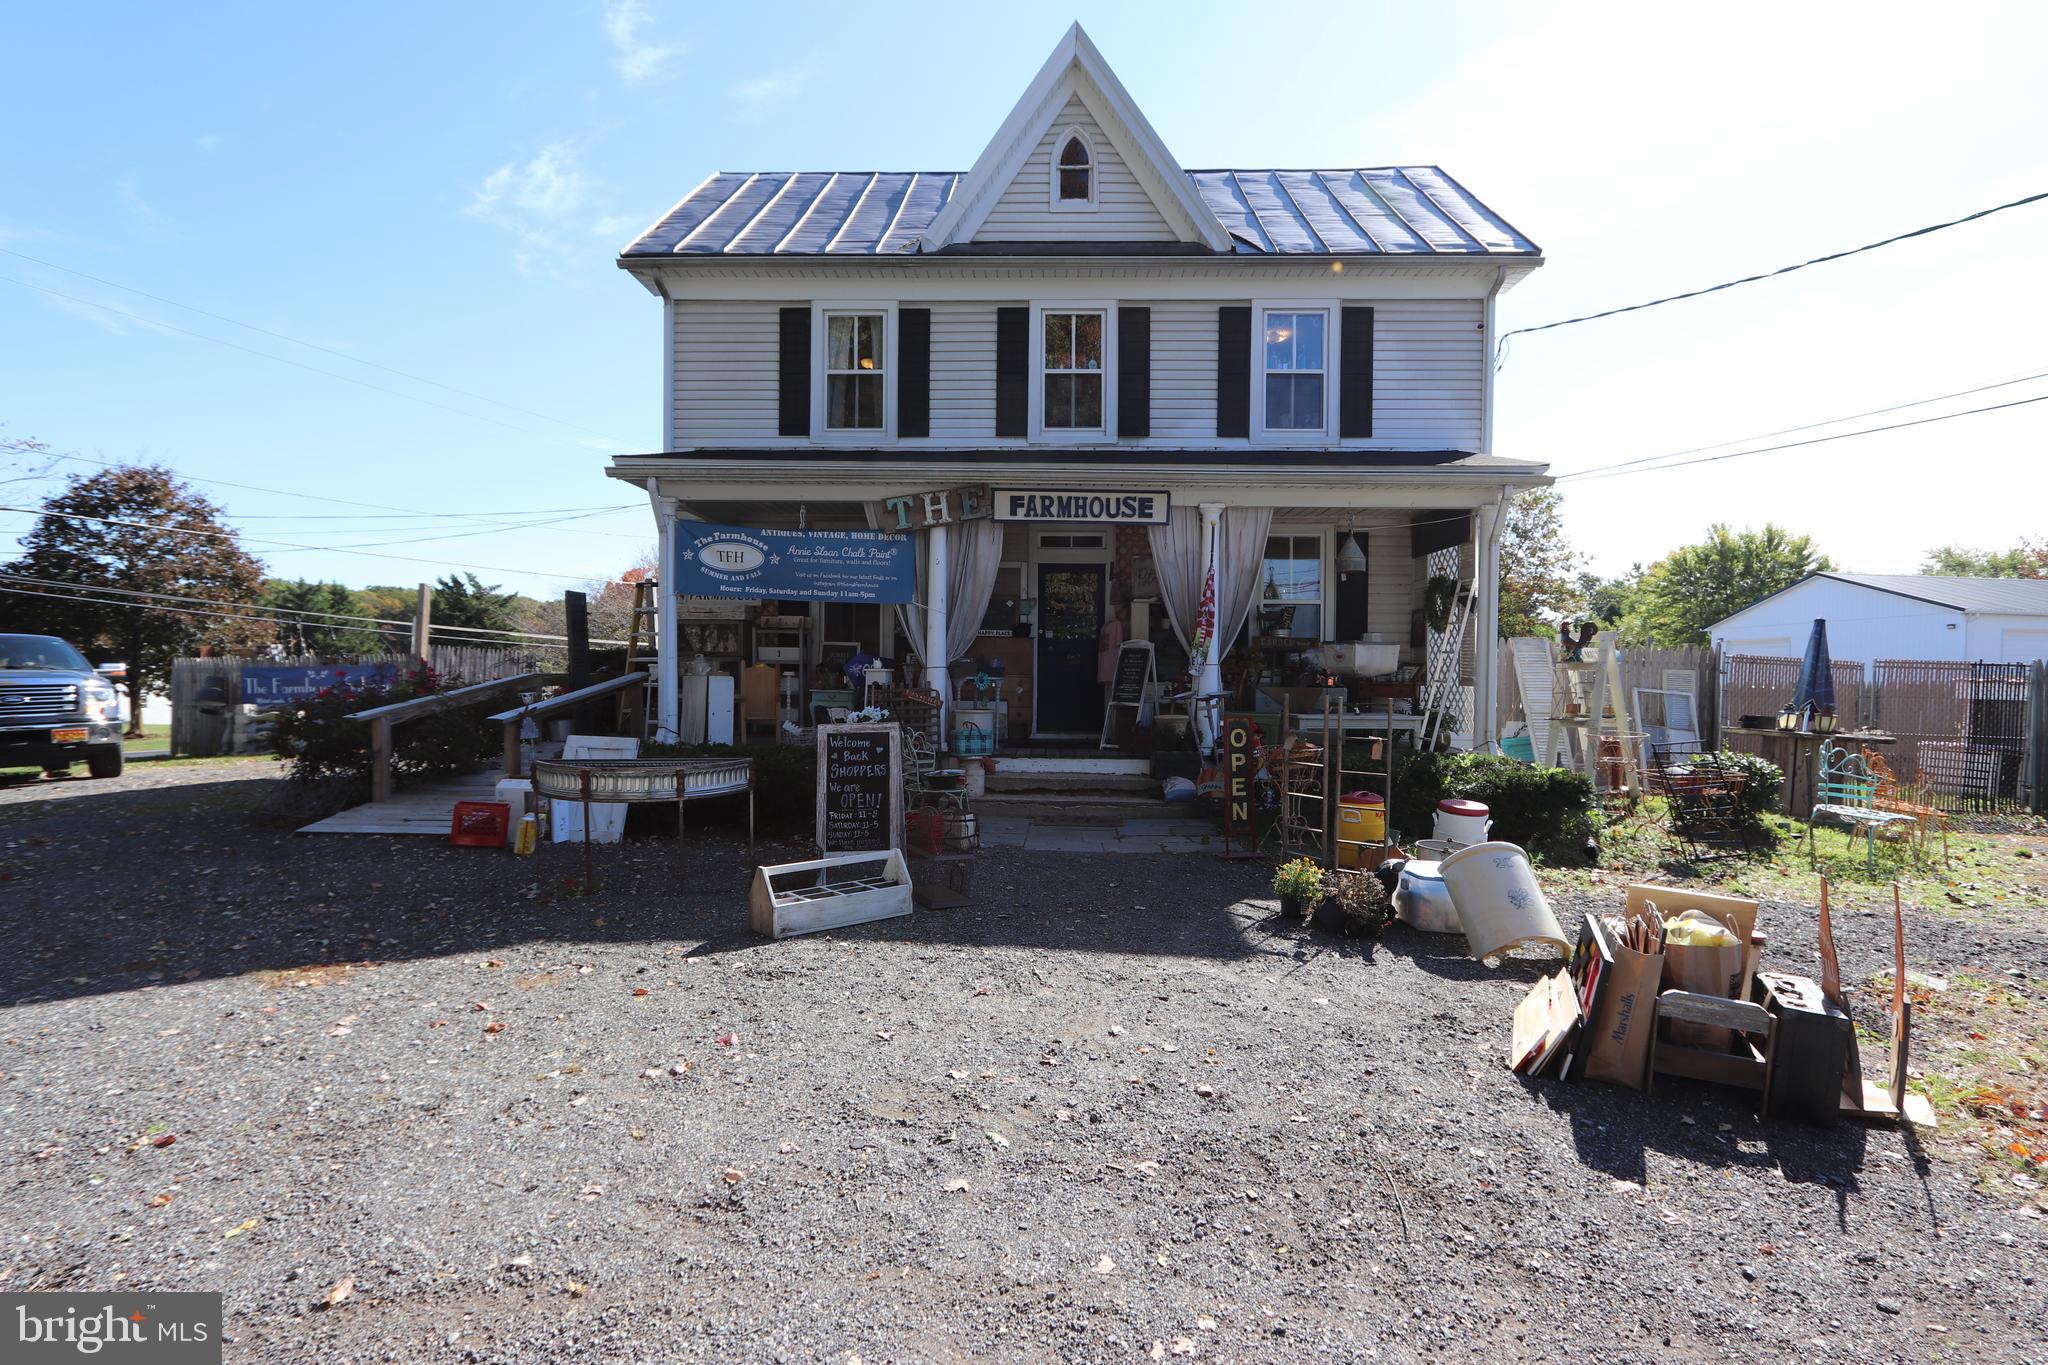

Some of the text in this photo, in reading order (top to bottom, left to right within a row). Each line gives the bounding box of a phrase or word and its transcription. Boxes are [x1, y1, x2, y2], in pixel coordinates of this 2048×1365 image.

[886, 485, 1154, 530] THE FARMHOUSE
[693, 532, 769, 551] The Farmhouse
[760, 529, 907, 541] ANTIQUES, VINTAGE, HOME DECOR
[716, 550, 744, 563] TFH
[787, 545, 812, 556] Annie
[814, 546, 839, 557] Sloan
[841, 547, 866, 558] Chalk
[700, 566, 763, 581] SUMMER AND FALL
[720, 585, 743, 593] Hours:
[745, 587, 768, 595] Friday,
[769, 588, 797, 597] Saturday
[813, 590, 838, 598] Sunday
[840, 590, 876, 598] 11am-5pm
[244, 677, 268, 694] The
[830, 736, 871, 748] Welcome
[844, 751, 869, 762] Back
[831, 764, 887, 778] SHOPPERS
[1230, 728, 1248, 821] OPEN
[830, 782, 861, 793] We are
[841, 793, 882, 808] OPEN!
[1611, 993, 1635, 1046] Marshalls
